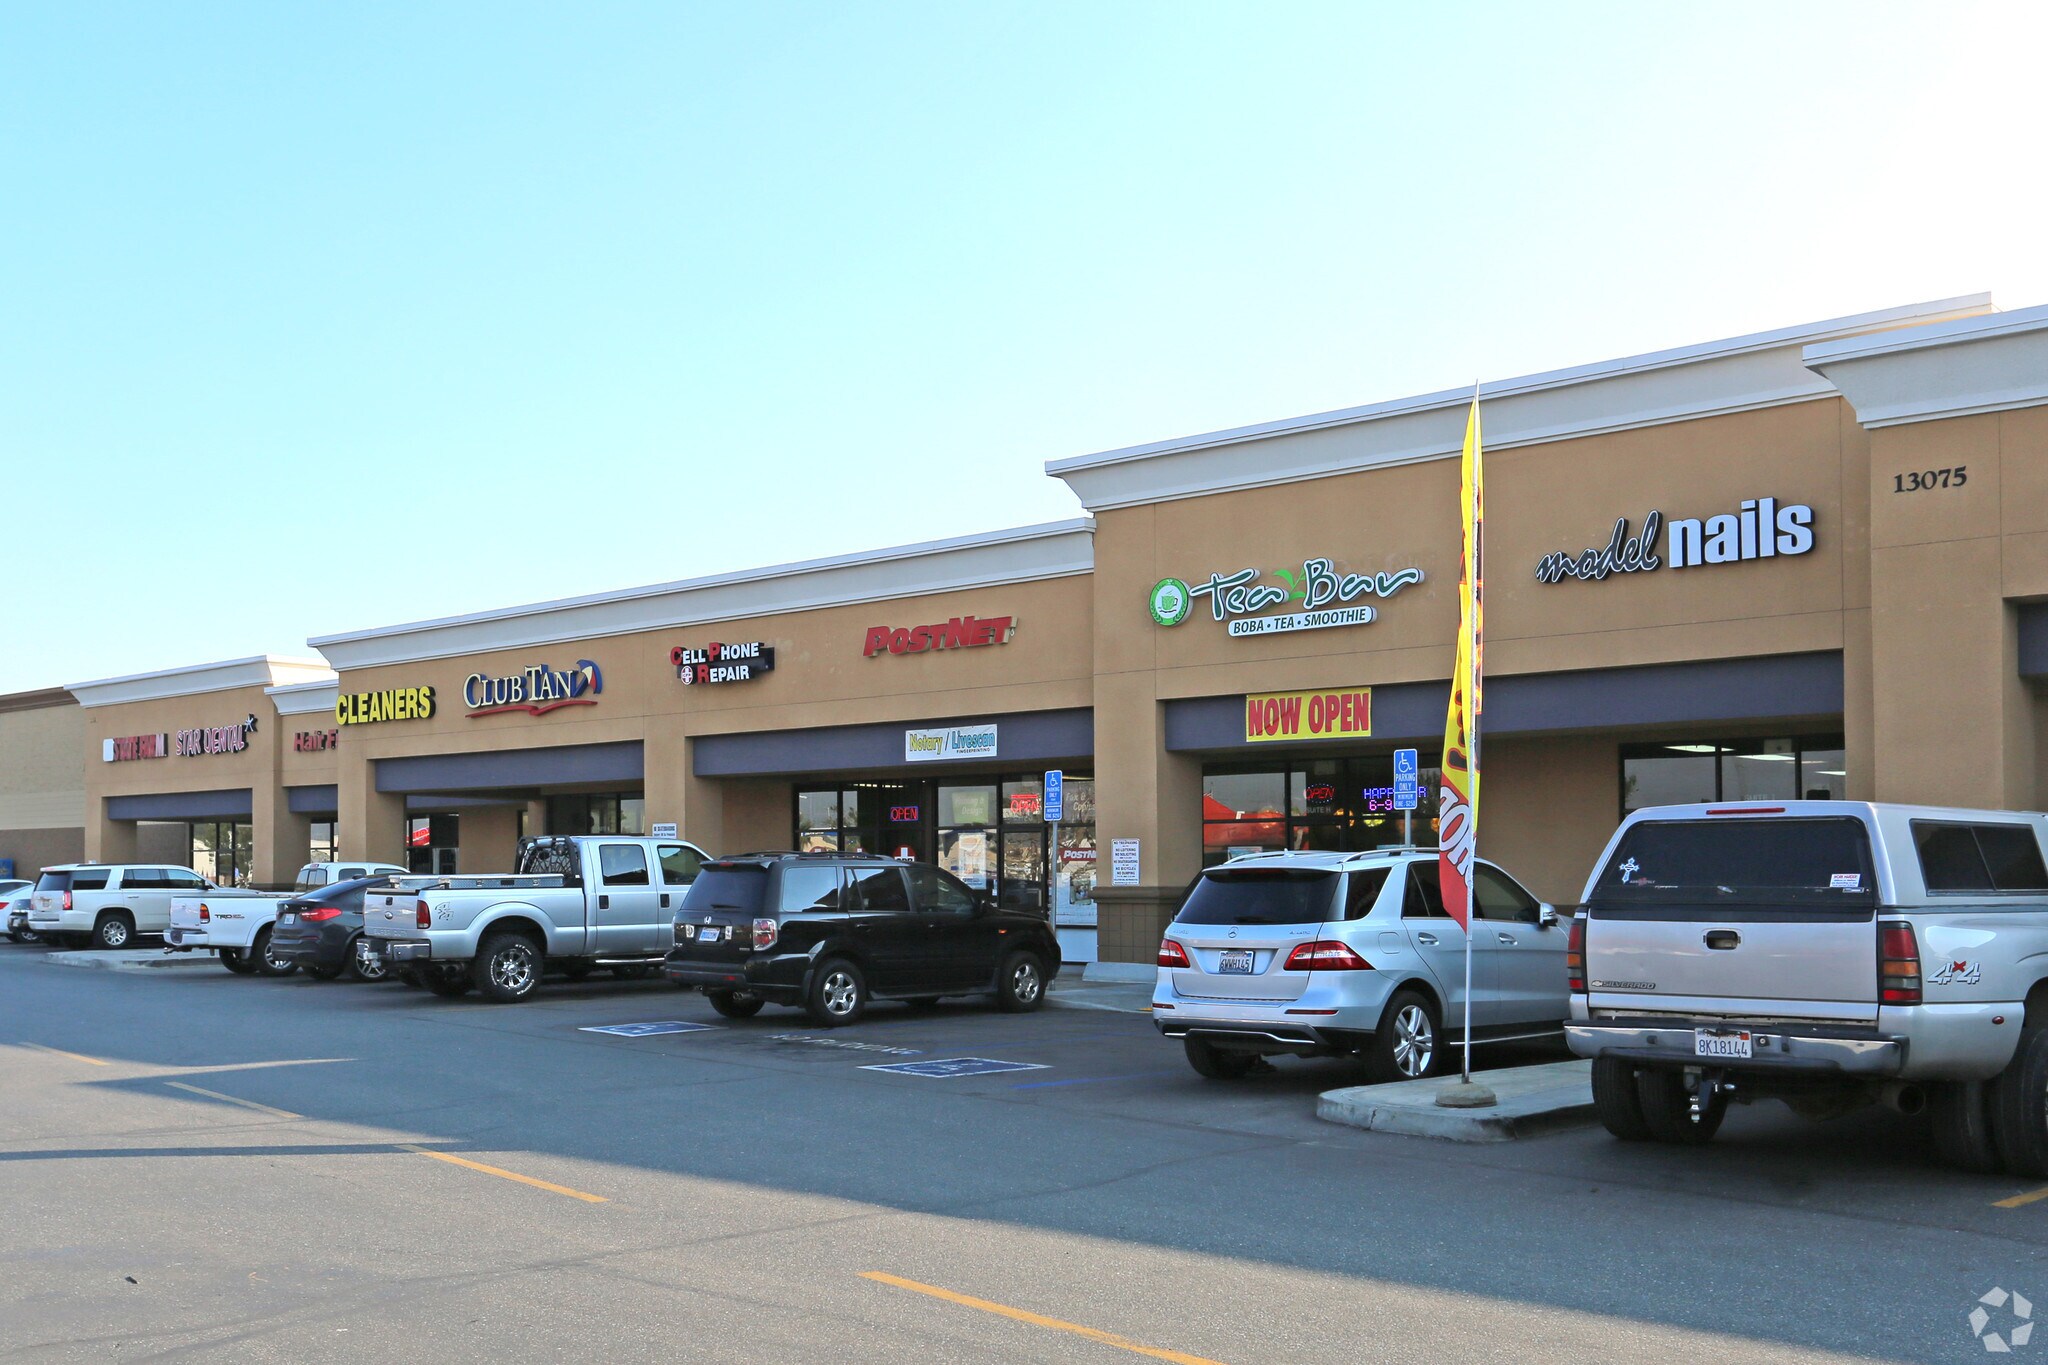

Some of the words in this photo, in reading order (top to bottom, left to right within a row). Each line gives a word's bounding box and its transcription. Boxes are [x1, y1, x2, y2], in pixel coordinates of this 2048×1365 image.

[1893, 465, 1967, 493] 13075
[1534, 509, 1662, 583] model
[1668, 496, 1815, 570] nails
[1189, 567, 1287, 621] Tea
[1302, 557, 1422, 609] Bar
[1233, 620, 1264, 634] BOBA
[1274, 616, 1295, 630] TEA
[1303, 608, 1367, 627] SMOOTHIE
[670, 645, 706, 666] CELL
[708, 641, 760, 662] PHONE
[697, 664, 750, 684] REPAIR
[335, 685, 435, 726] CLEANERS
[1247, 697, 1302, 737] NOW
[1308, 692, 1369, 735] OPEN
[175, 727, 202, 757] STAR
[204, 724, 246, 755] DENTAL
[293, 730, 324, 752] Hair
[909, 733, 943, 755] Notary
[951, 730, 996, 750] Livescan
[1395, 773, 1416, 782] PARKING
[1399, 782, 1413, 791] ONLY
[1303, 787, 1335, 800] OPEN
[1363, 787, 1395, 799] HAPP
[891, 807, 917, 821] OPEN
[1010, 799, 1039, 813] OPEN
[1602, 981, 1655, 990] SILVERADO
[1698, 1039, 1748, 1056] 8K18144
